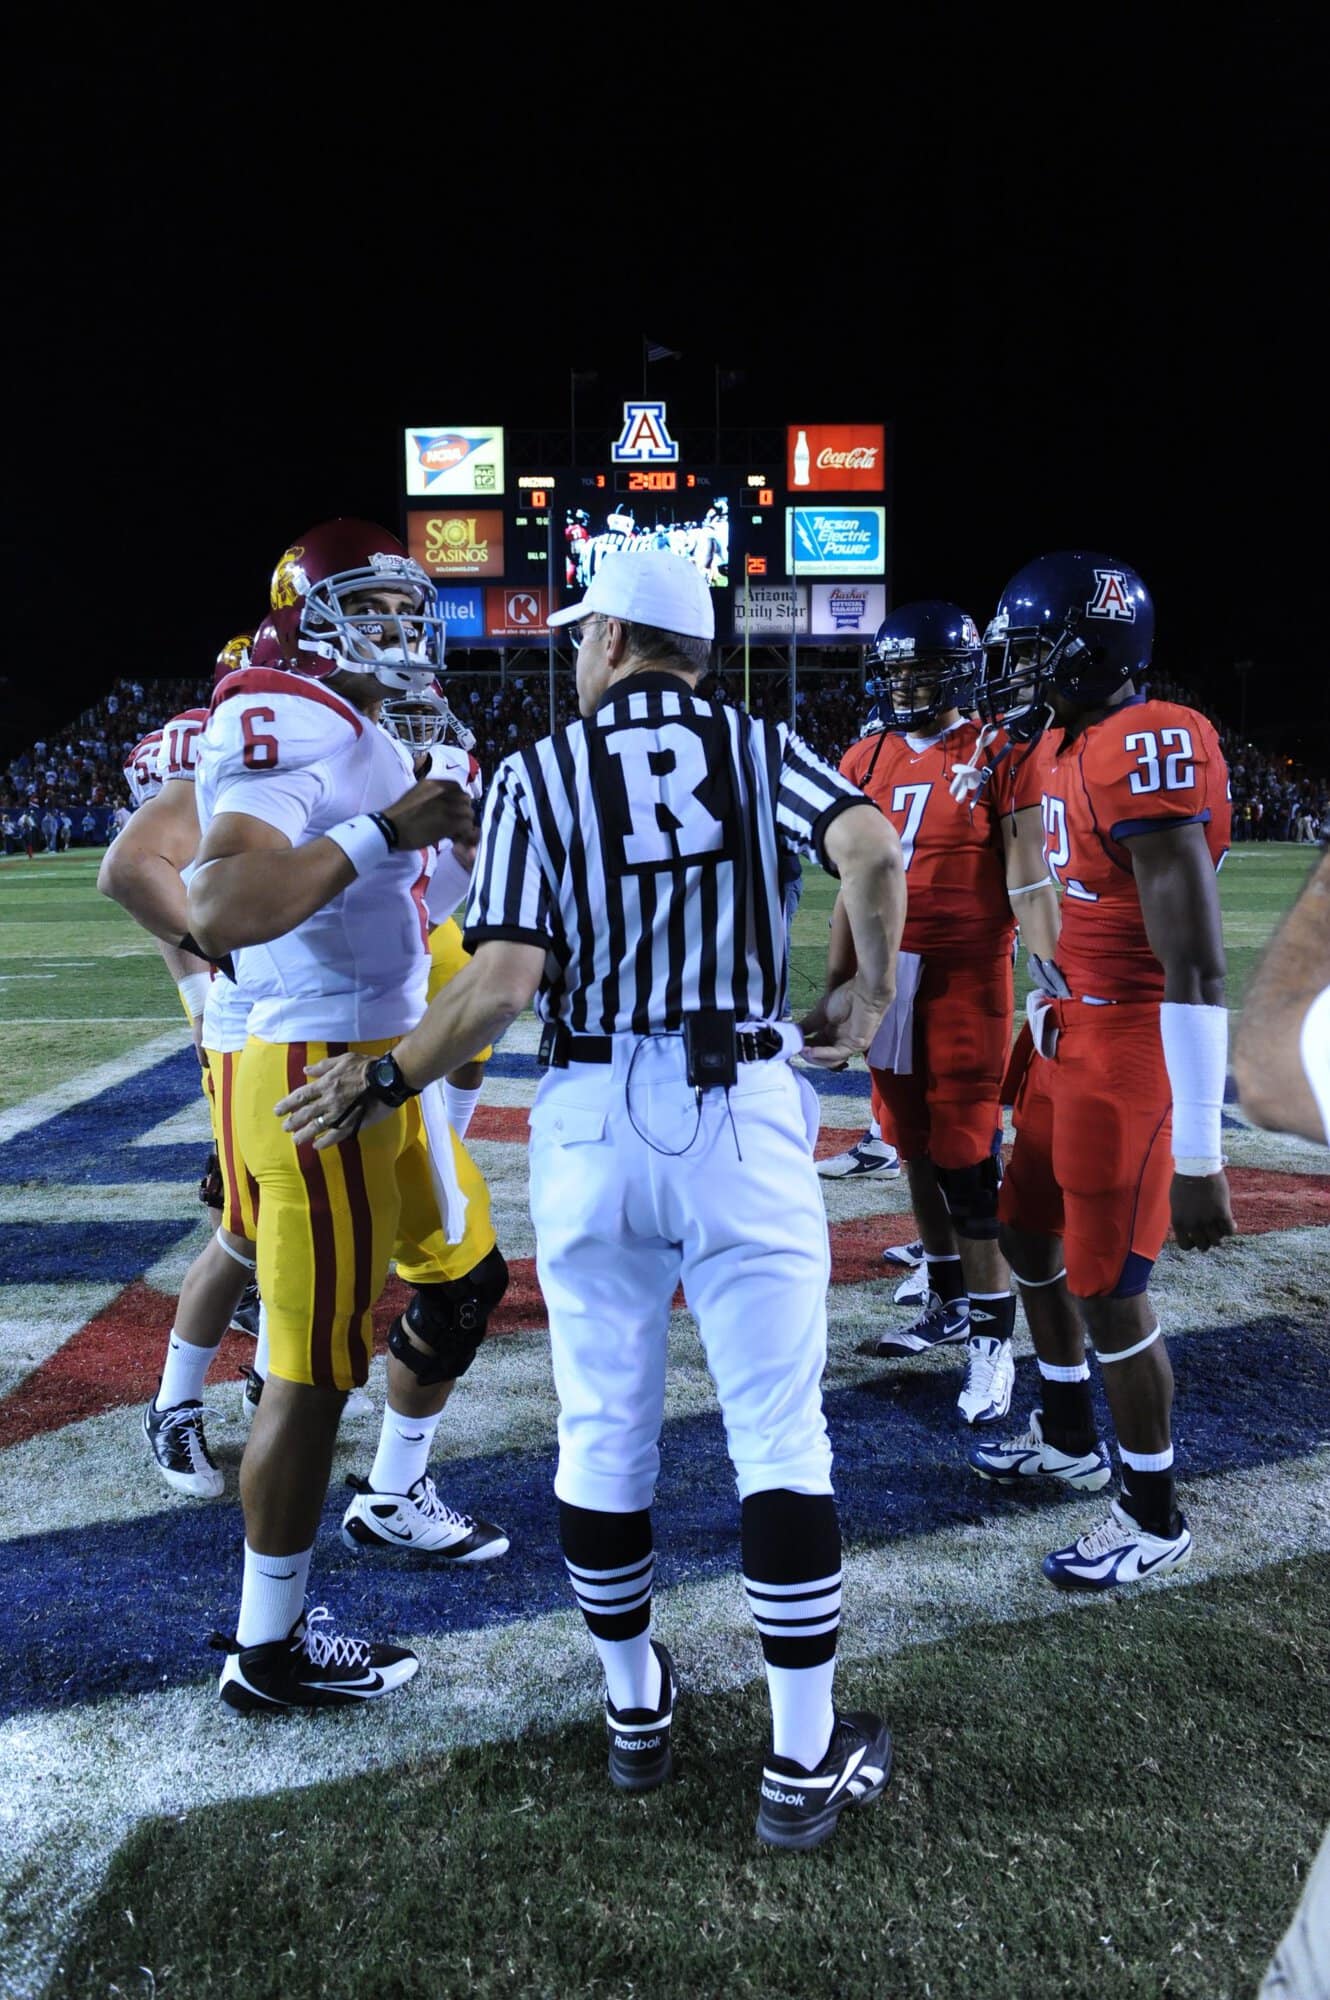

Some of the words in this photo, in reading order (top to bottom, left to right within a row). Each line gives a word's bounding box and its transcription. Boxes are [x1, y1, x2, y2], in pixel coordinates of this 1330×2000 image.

[612, 401, 679, 462] A
[816, 447, 879, 469] Coca-Cola
[628, 472, 676, 490] 2:00
[686, 474, 695, 487] 3
[532, 491, 546, 507] 0
[759, 489, 773, 505] 0
[813, 517, 859, 530] Tucson
[425, 518, 488, 549] SOL
[817, 530, 871, 542] Electric
[425, 549, 488, 562] CASINOS
[823, 542, 871, 555] Power
[747, 557, 766, 574] 25
[744, 586, 798, 601] Arizona
[1086, 569, 1136, 622] A
[776, 603, 807, 617] Star
[240, 706, 279, 770] 6
[1124, 727, 1196, 796] 32
[605, 722, 724, 865] R
[891, 783, 934, 873] 7
[614, 1734, 661, 1751] Reebok
[761, 1780, 806, 1807] eebok
